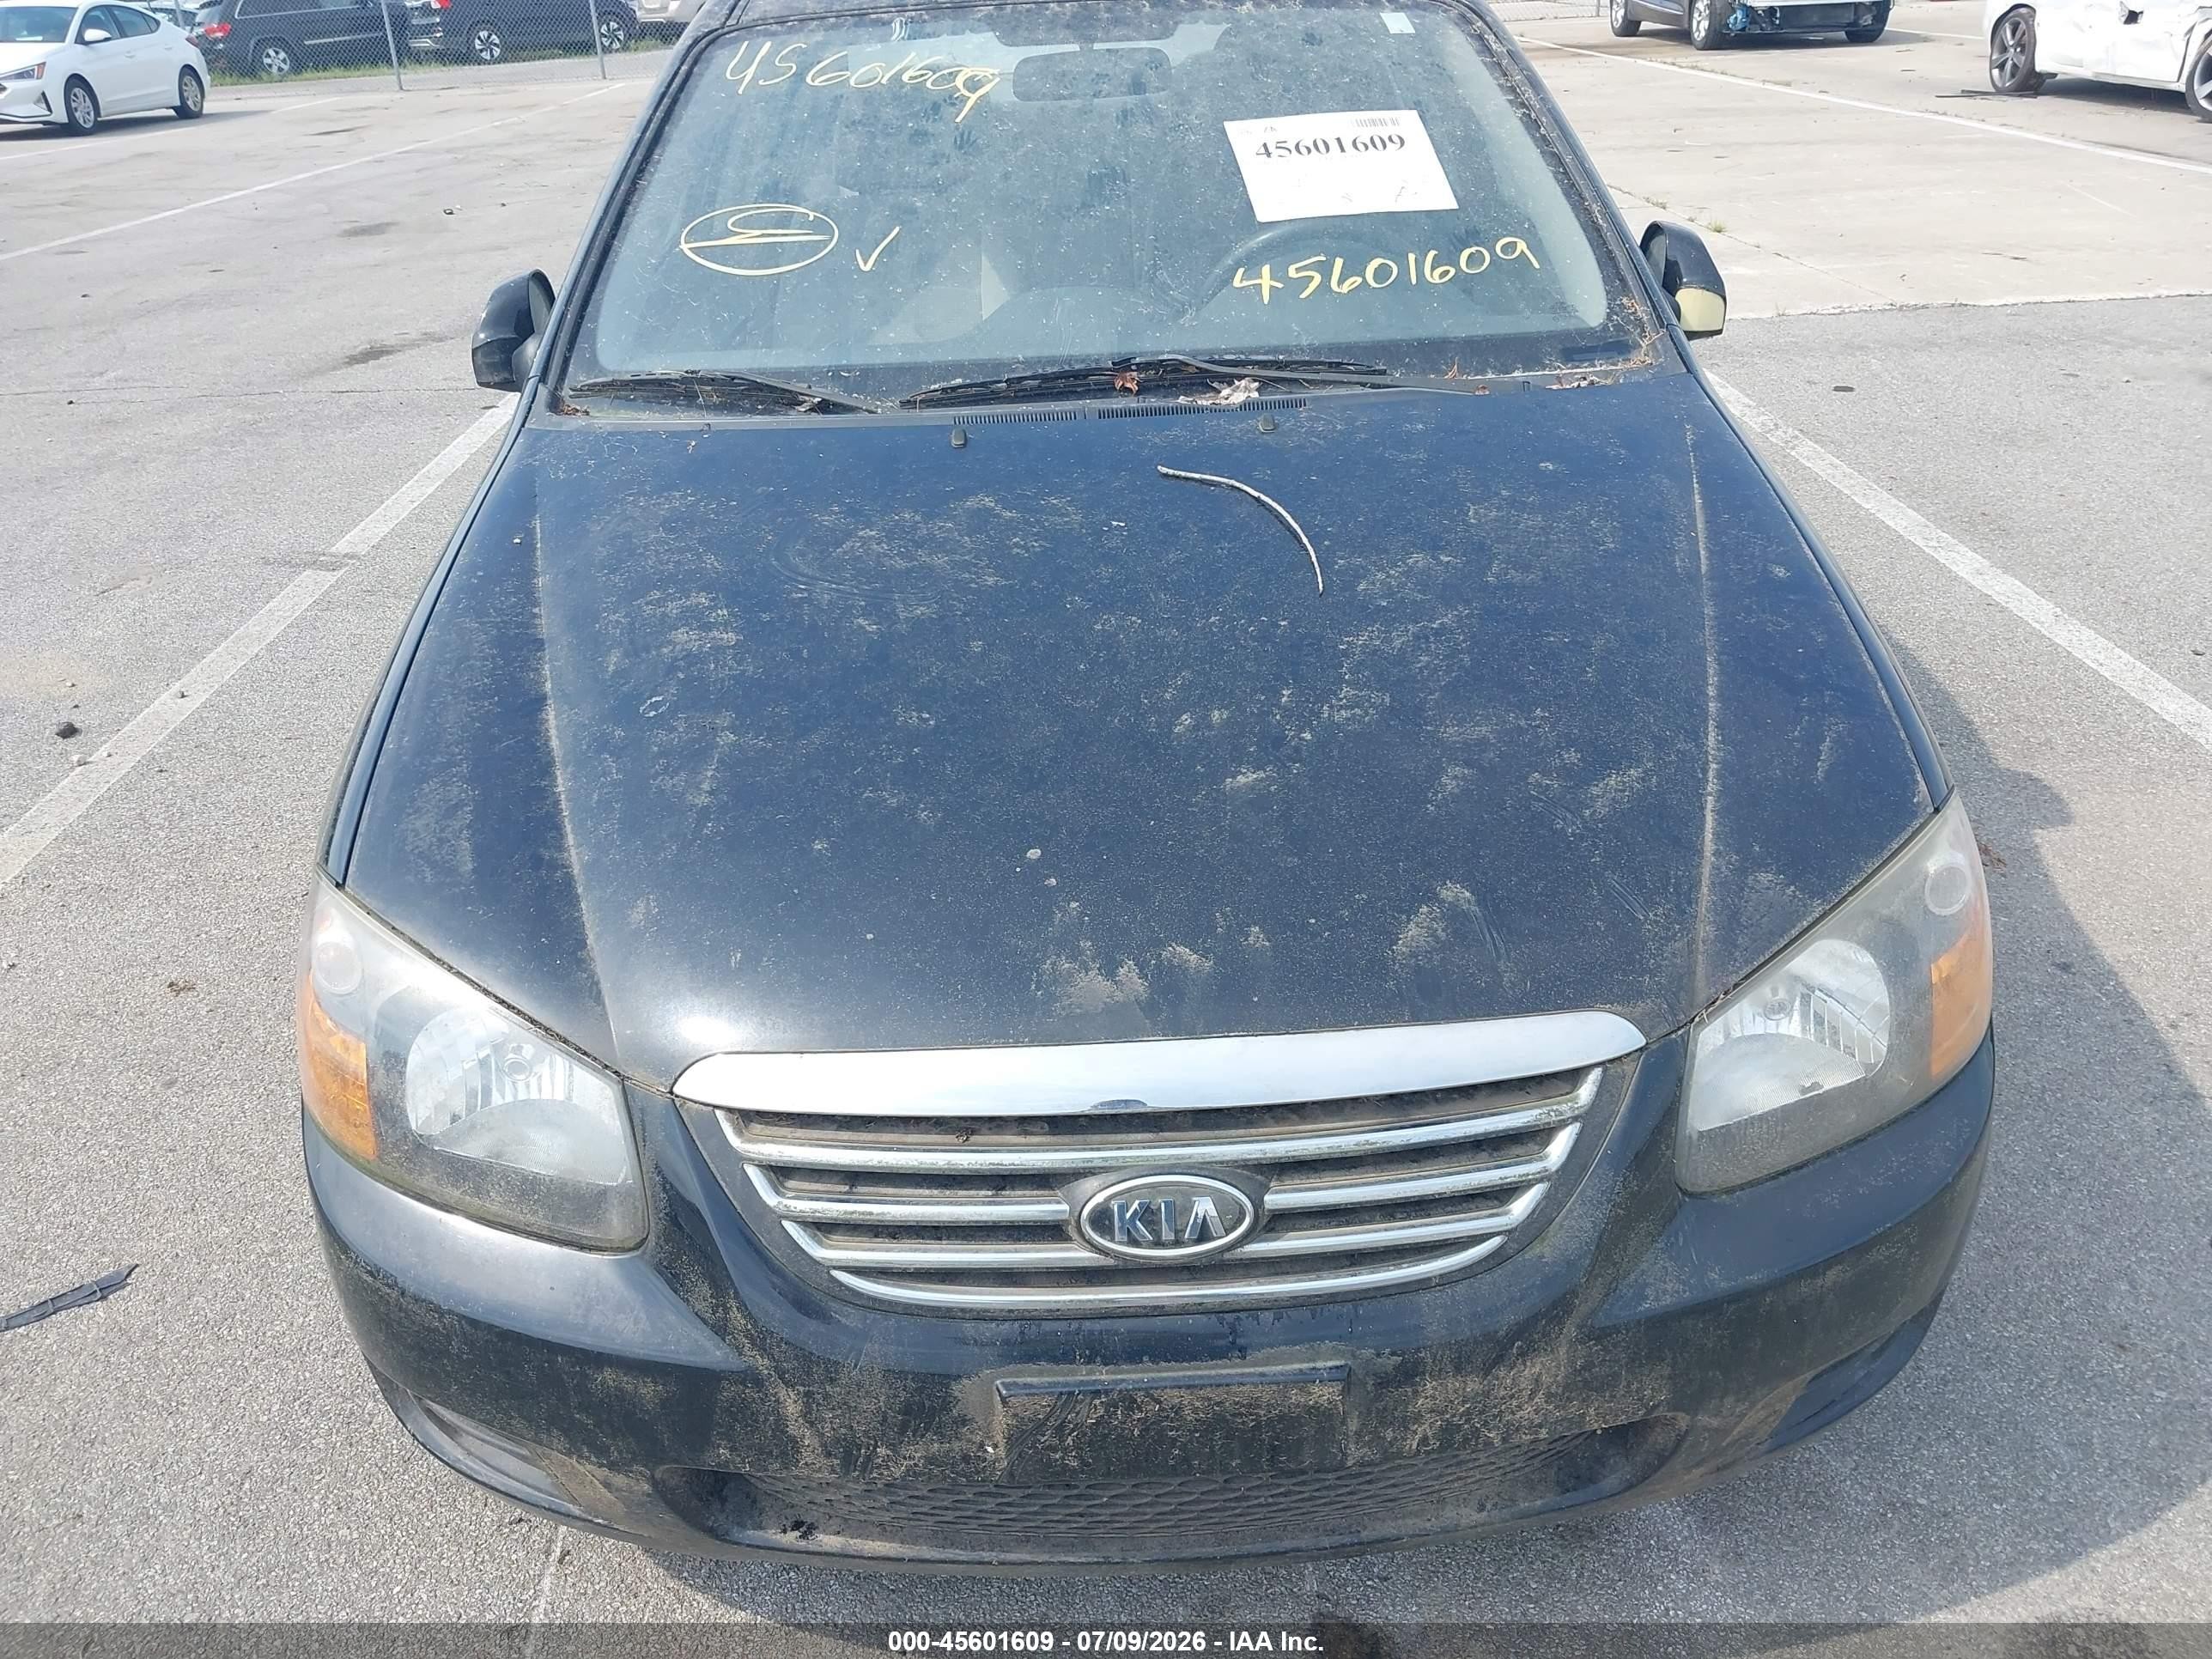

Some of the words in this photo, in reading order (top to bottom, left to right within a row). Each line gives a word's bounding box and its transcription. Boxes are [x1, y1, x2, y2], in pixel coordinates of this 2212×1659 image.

[724, 40, 1000, 123] 45601609
[1255, 133, 1407, 159] 45601609
[1231, 236, 1540, 305] 45601609
[1110, 1196, 1227, 1242] KIA
